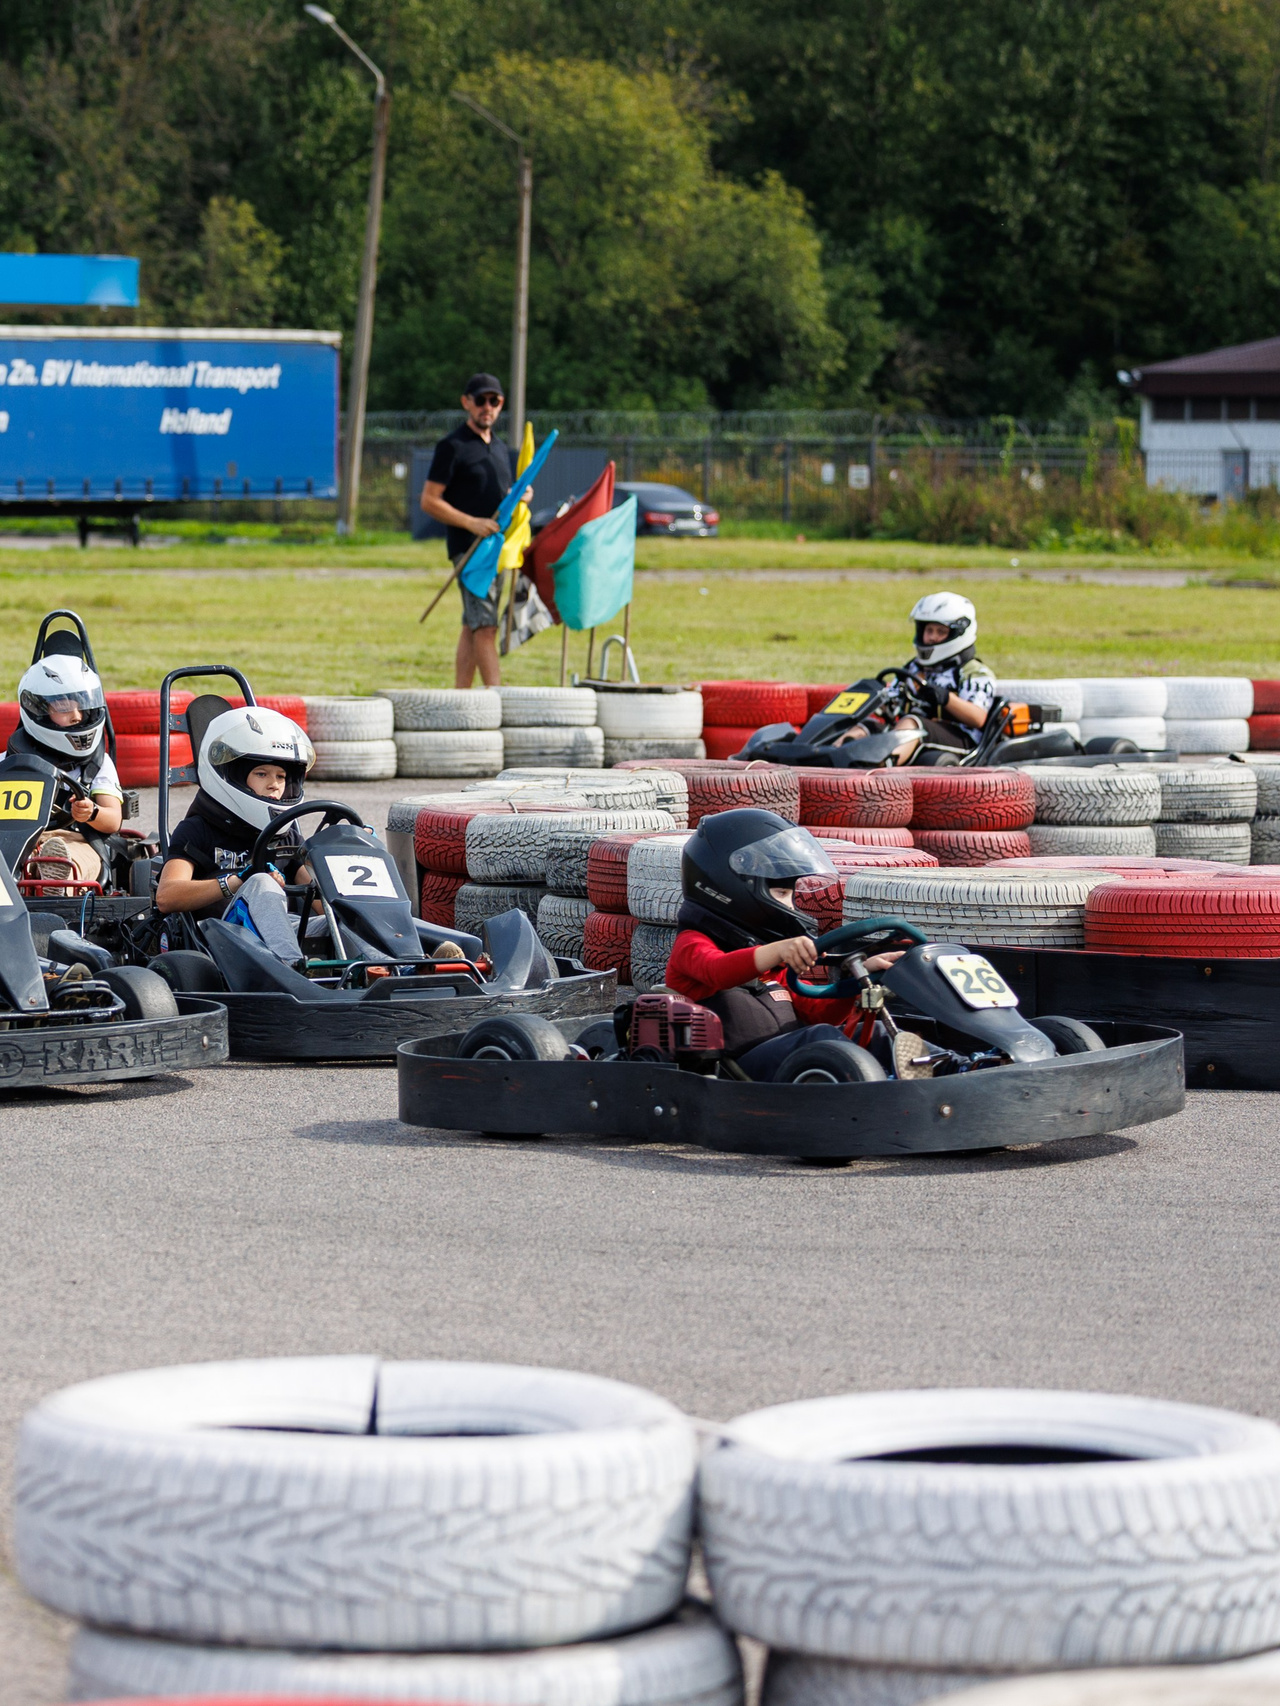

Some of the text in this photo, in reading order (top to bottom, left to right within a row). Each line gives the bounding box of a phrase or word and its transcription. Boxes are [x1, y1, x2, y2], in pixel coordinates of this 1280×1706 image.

[7, 358, 38, 386] Zn.
[40, 359, 73, 387] BV
[195, 361, 281, 394] Transport
[159, 407, 232, 434] Holland
[838, 697, 855, 708] 3
[2, 790, 32, 811] 10
[348, 865, 378, 887] 2
[695, 881, 732, 905] LS2
[950, 968, 1006, 994] 26
